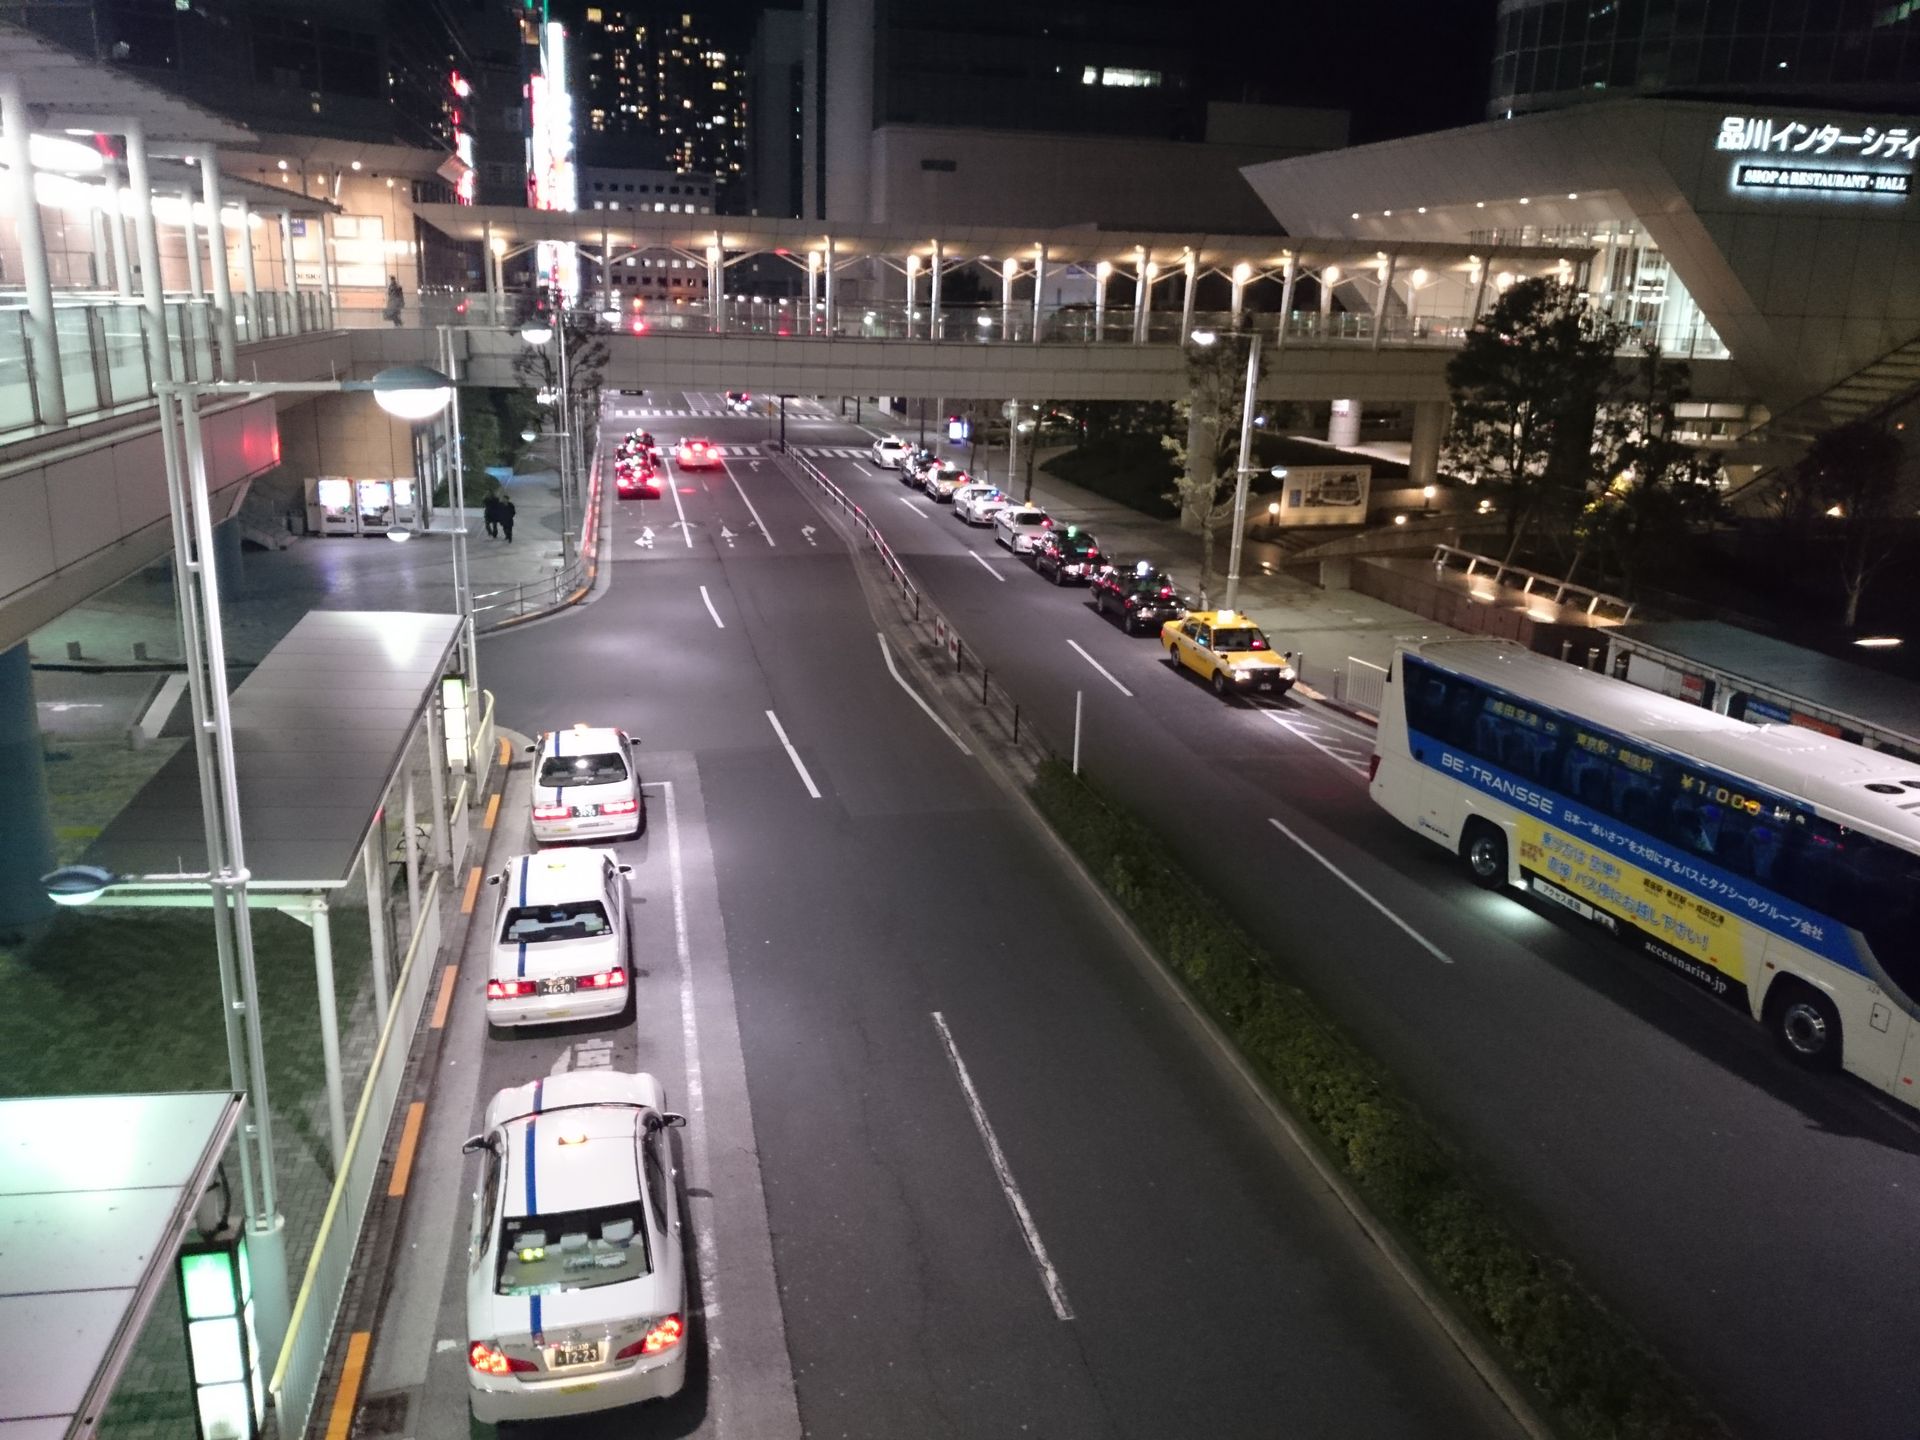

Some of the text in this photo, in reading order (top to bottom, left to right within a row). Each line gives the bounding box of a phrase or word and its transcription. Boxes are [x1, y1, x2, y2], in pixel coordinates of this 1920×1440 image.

[1716, 115, 1920, 159] 品川インターシティ
[1743, 168, 1779, 184] SHOP
[1875, 177, 1908, 191] HALL
[1645, 941, 1727, 994] accessnarita.jp
